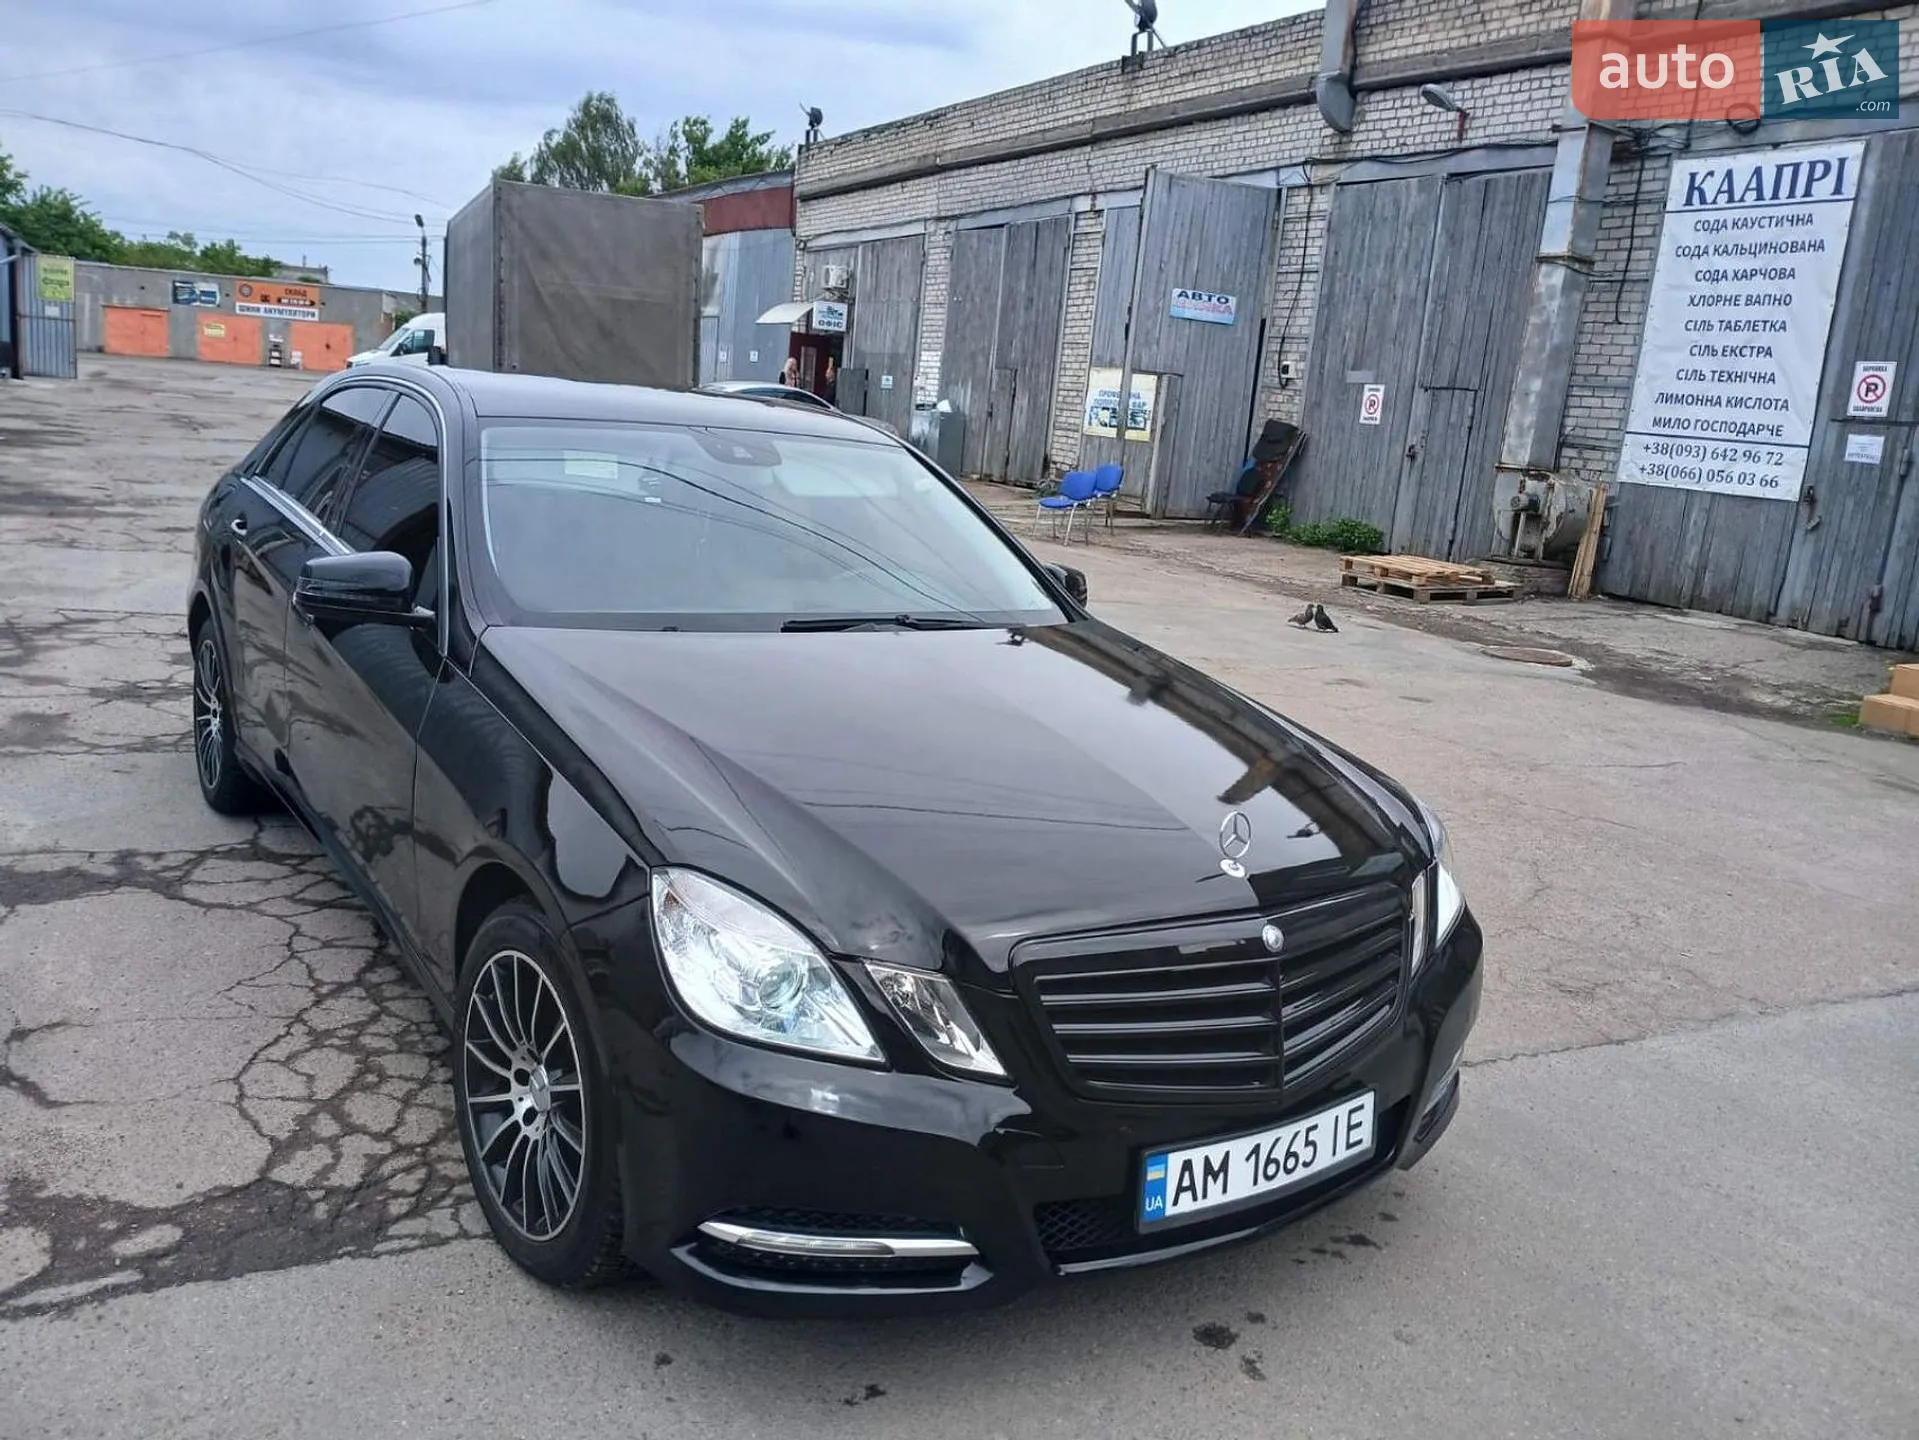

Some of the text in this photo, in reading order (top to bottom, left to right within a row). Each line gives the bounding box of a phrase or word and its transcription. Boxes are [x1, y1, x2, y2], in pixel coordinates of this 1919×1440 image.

[1683, 157, 1849, 207] КААПРІ
[1694, 213, 1814, 234] СОДА КАУСТИЧНА
[1675, 238, 1826, 260] СОДА КАЛЬЦИНОВАНА
[1695, 267, 1796, 284] СОДА ХАРЧОВА
[1177, 290, 1229, 305] АВТО
[1687, 293, 1793, 307] ХЛОРНЕ ВАПНО
[818, 319, 844, 328] ОФІС
[1684, 319, 1787, 333] СІЛЬ ТАБЛЕТКА
[1689, 344, 1773, 358] СІЛЬ ЕКСТРА
[1676, 368, 1776, 385] СІЛЬ ТЕХНІЧНА
[1654, 392, 1790, 411] ЛИМОННА КИСЛОТА
[1652, 416, 1785, 437] МИЛО ГОСПОДАРЧЕ
[1643, 442, 1784, 466] +38(093) 642 96 72
[1639, 463, 1779, 489] +38(066) 056 03 66
[1172, 1103, 1366, 1207] AM 1665 IE
[1145, 1196, 1163, 1212] UA
